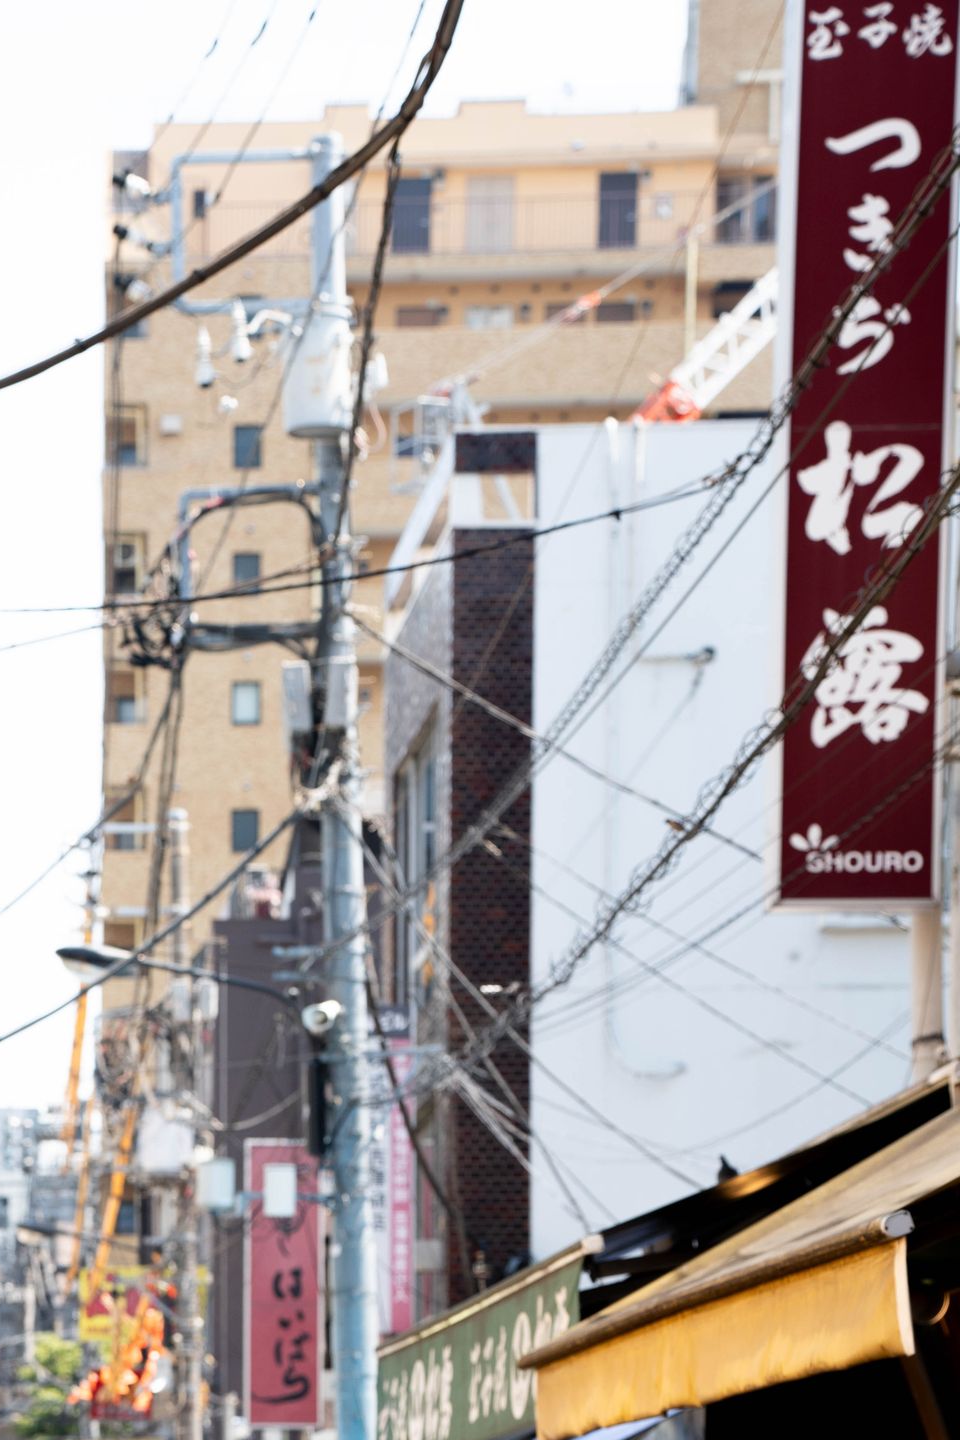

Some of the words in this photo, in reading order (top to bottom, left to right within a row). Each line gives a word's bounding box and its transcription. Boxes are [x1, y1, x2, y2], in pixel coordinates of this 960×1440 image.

[808, 3, 952, 60] 玉子焼
[806, 850, 924, 873] SHOURO
